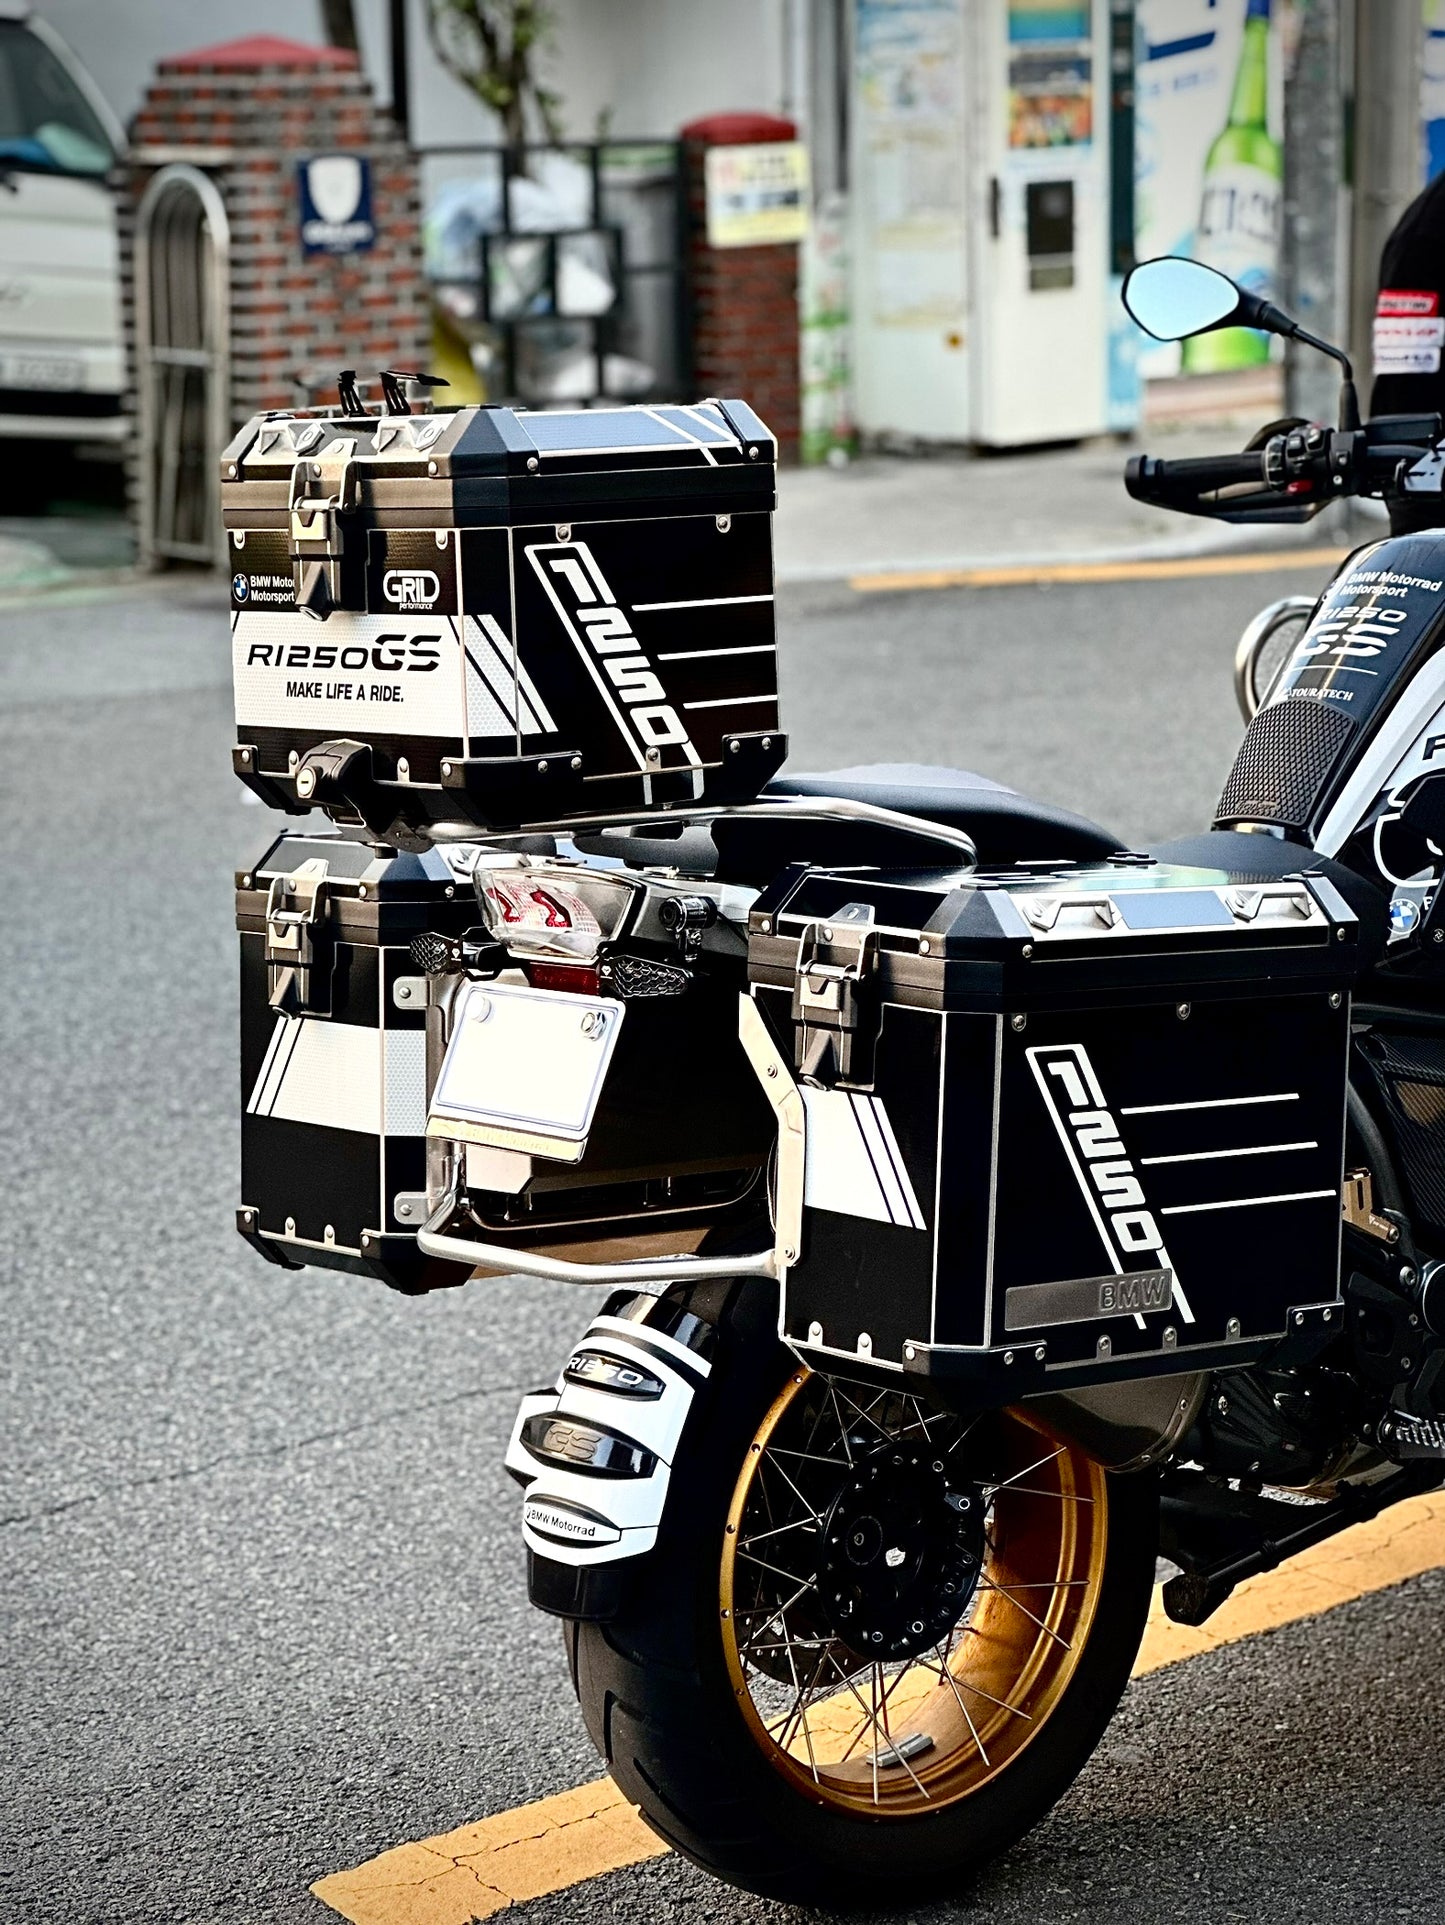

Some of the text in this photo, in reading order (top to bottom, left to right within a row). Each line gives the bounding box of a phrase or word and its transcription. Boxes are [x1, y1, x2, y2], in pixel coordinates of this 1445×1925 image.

[250, 575, 271, 588] BMW
[383, 570, 440, 603] GRID
[1340, 584, 1408, 598] Motorsport
[1347, 571, 1443, 592] BMW Motorrad
[251, 590, 295, 604] Motorsport
[399, 600, 433, 611] performance
[549, 558, 690, 746] 1250
[286, 681, 404, 703] MAKE LIFE A RIDE.
[1291, 687, 1354, 701] TOURATECH
[1047, 1061, 1164, 1252] 1250
[1099, 1275, 1166, 1312] BMW
[543, 1423, 602, 1460] GS
[531, 1509, 596, 1537] BMW Motorrad
